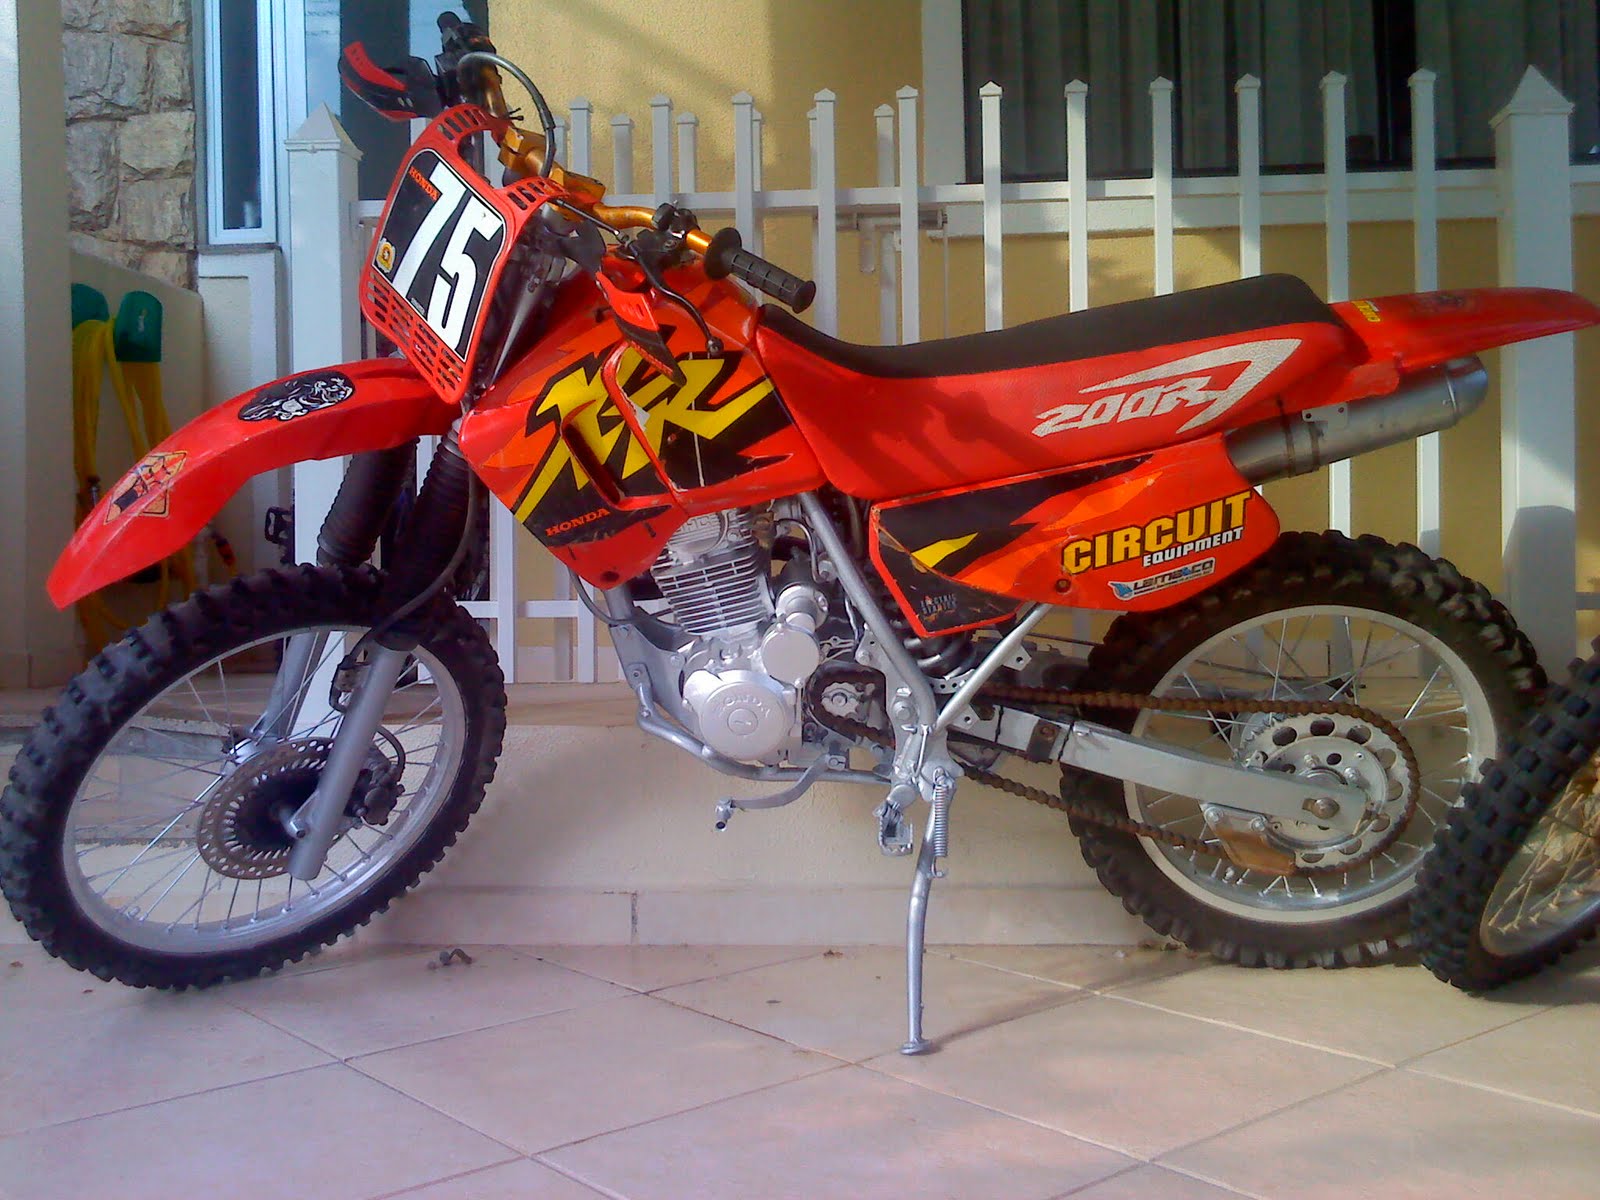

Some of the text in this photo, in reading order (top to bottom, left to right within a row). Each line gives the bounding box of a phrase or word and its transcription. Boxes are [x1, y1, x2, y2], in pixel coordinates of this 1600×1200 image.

[408, 166, 440, 201] HONDA
[393, 160, 504, 351] 75
[546, 508, 610, 536] HONDA
[1063, 490, 1250, 574] CIRCUIT
[1143, 527, 1244, 567] EQUIPMENT
